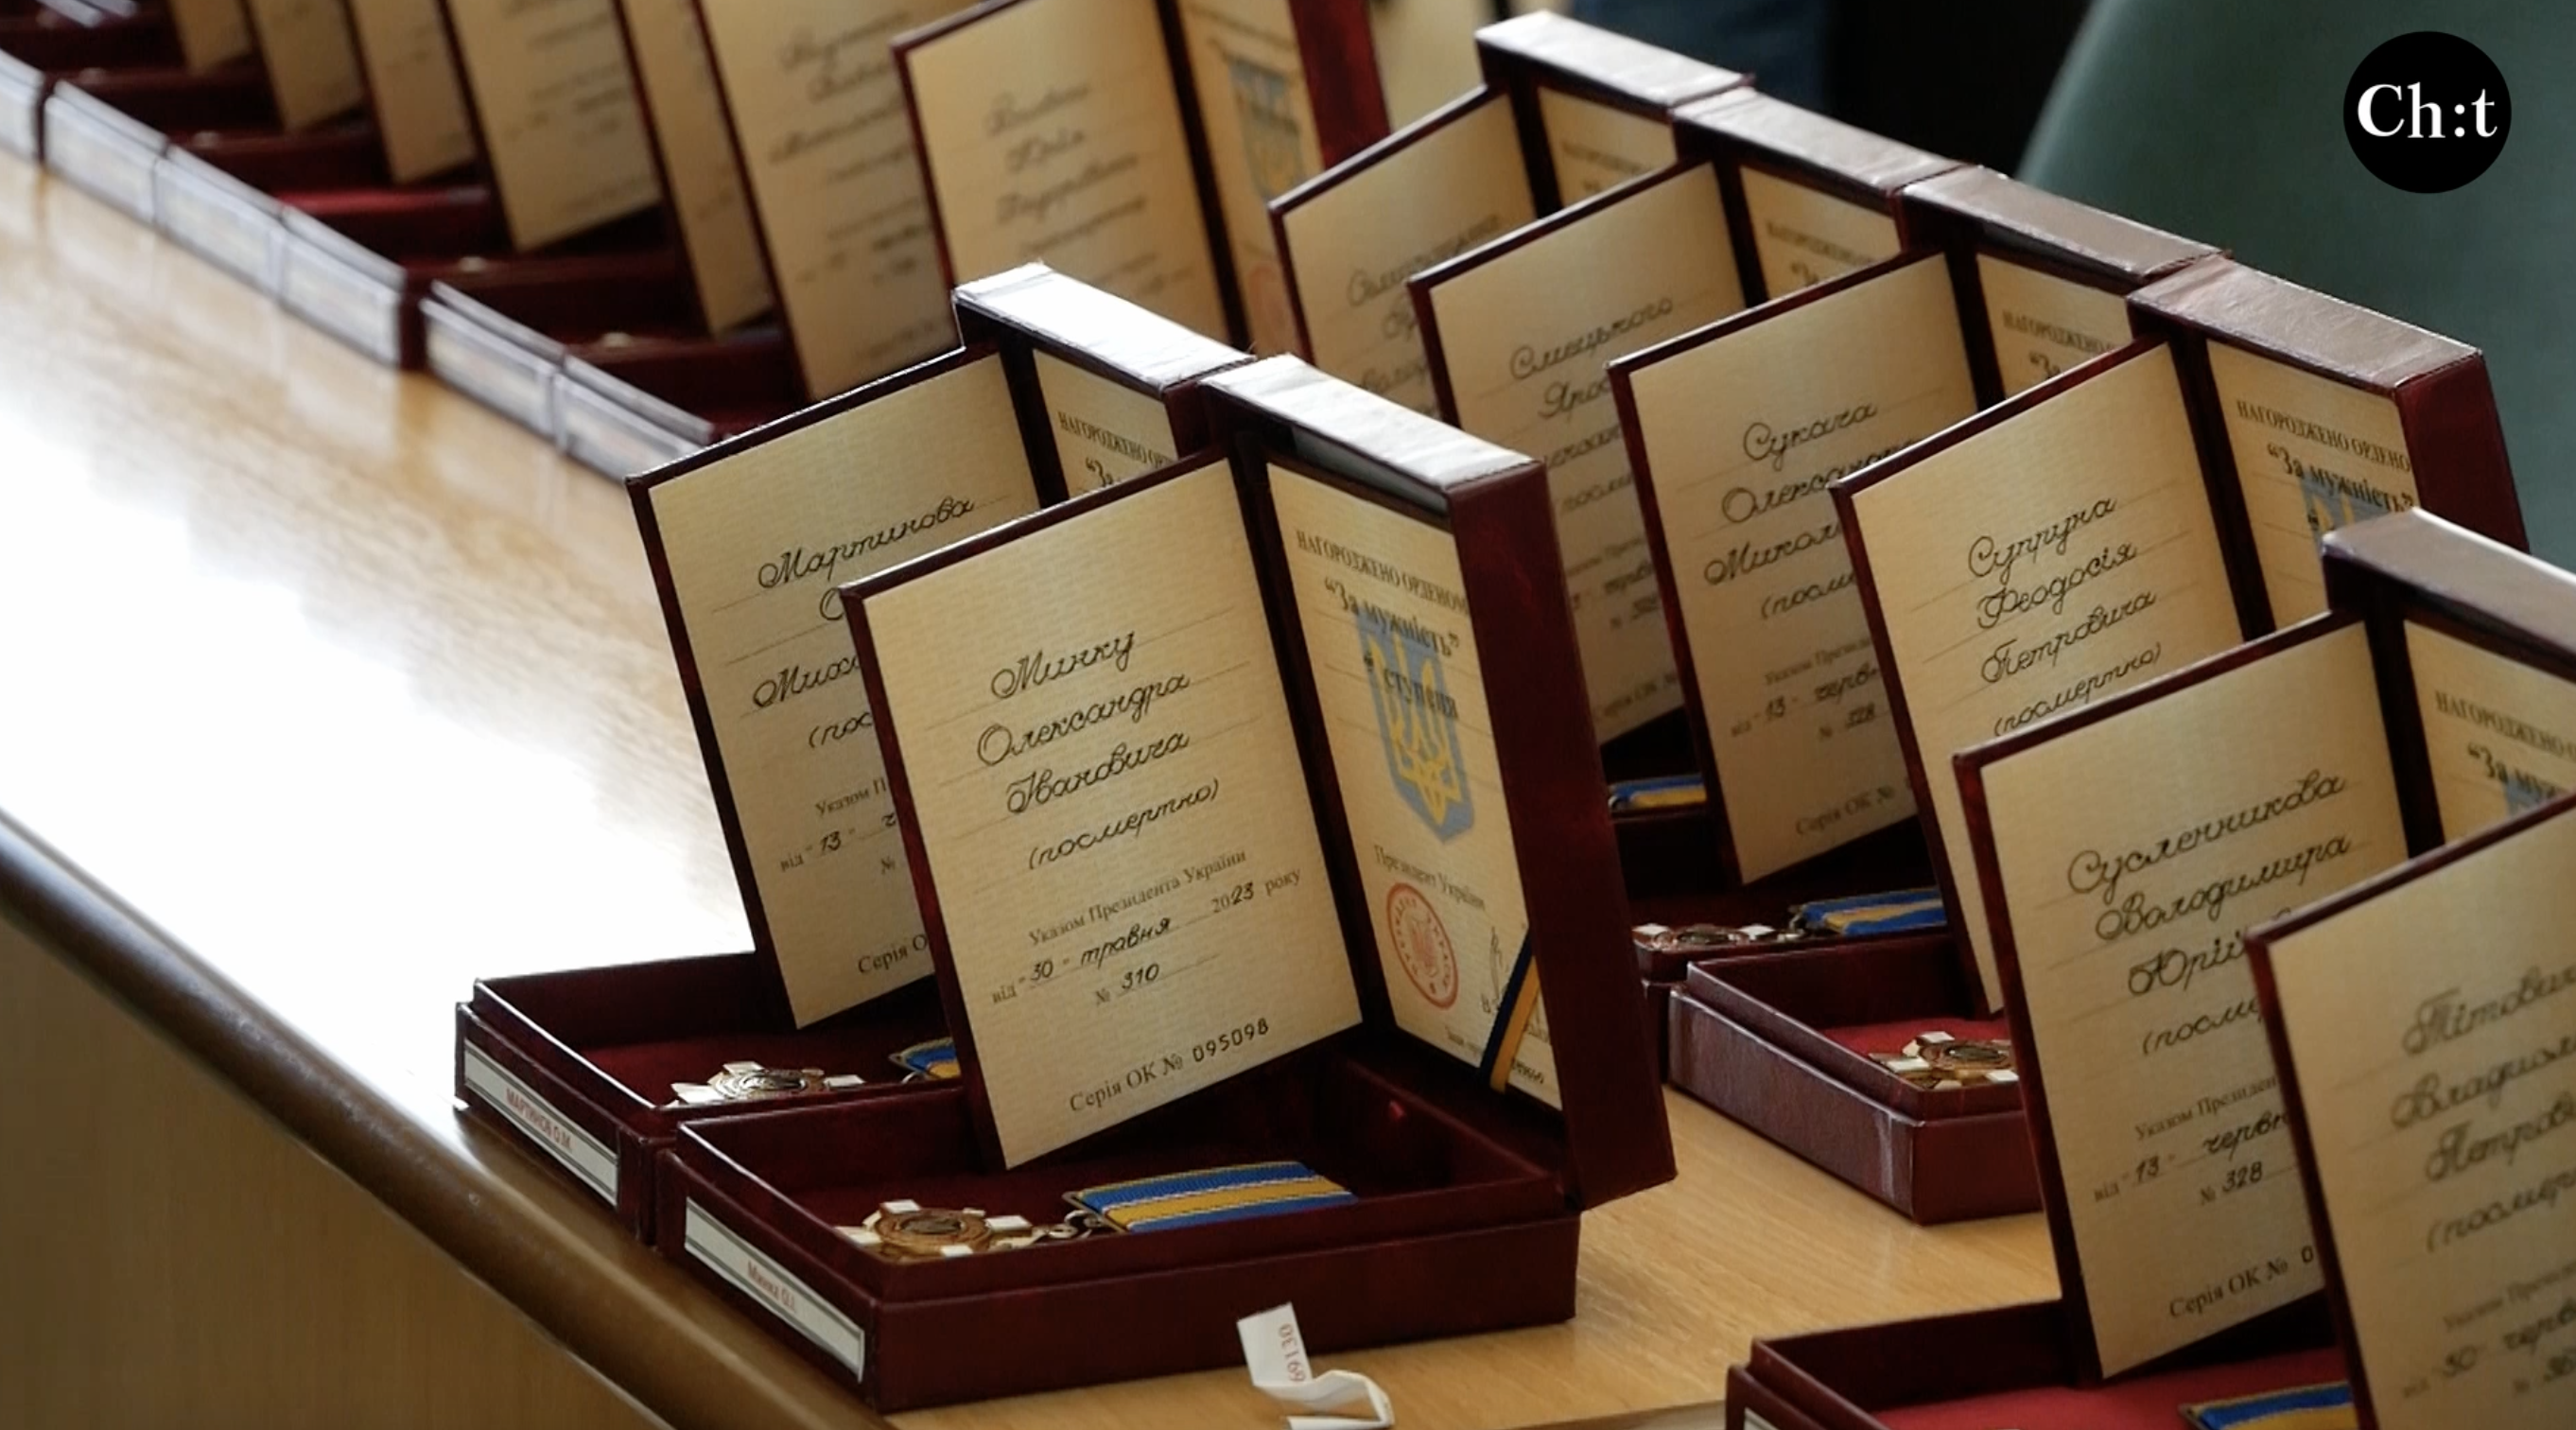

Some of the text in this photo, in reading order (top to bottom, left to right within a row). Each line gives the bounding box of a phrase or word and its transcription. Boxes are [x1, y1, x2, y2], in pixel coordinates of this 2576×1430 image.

[757, 495, 976, 589] Мартинова
[1296, 530, 1401, 587] НАГОРОДЖЕНО
[1968, 497, 2117, 585] Супруна
[991, 631, 1135, 699] Минку
[1994, 641, 2161, 737] (посмертно)
[978, 672, 1191, 767] Олександра
[1006, 731, 1191, 813] Івановича
[1029, 777, 1219, 869] (посмертно)
[1029, 849, 1247, 947] Указом Президента України
[1080, 916, 1172, 970] травня
[1210, 881, 1256, 916] 2023
[1264, 867, 1303, 898] року
[2095, 834, 2352, 940] Володимира
[857, 943, 909, 976] Серія
[1120, 962, 1161, 992] 310
[1069, 1016, 1271, 1113] Серія ОК № 095098
[2221, 1160, 2264, 1194] 328
[2167, 1283, 2225, 1319] Серія
[2227, 1267, 2261, 1297] ОК
